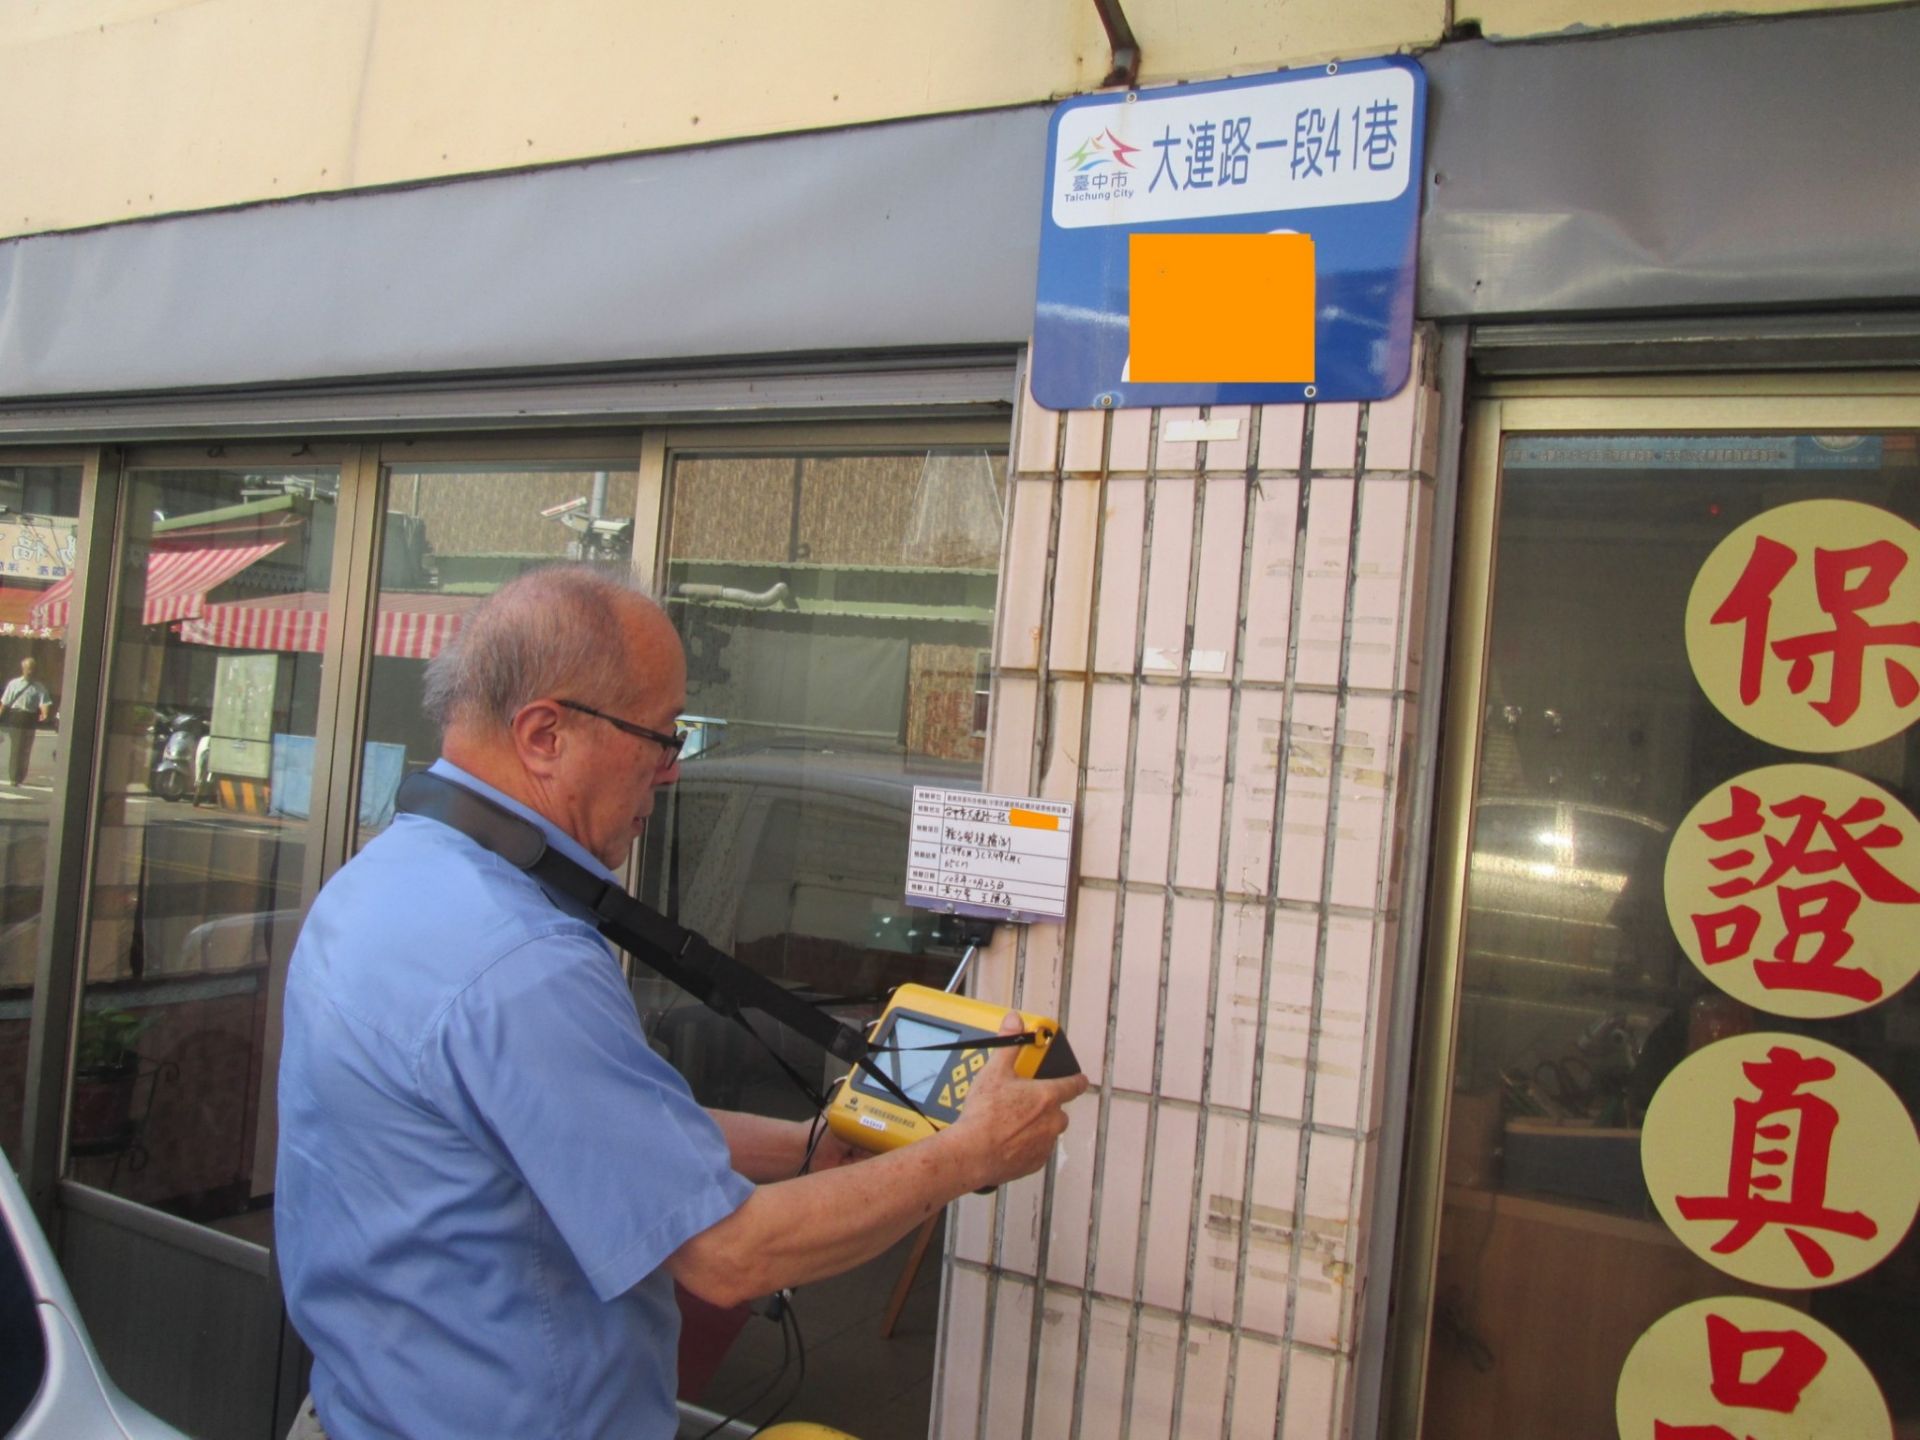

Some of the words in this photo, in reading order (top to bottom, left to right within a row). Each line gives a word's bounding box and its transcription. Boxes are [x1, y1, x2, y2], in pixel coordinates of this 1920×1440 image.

[1148, 98, 1399, 194] 大連路一段41巷
[1072, 171, 1128, 192] 臺中市
[1064, 191, 1111, 203] Taichung
[1113, 188, 1134, 199] City
